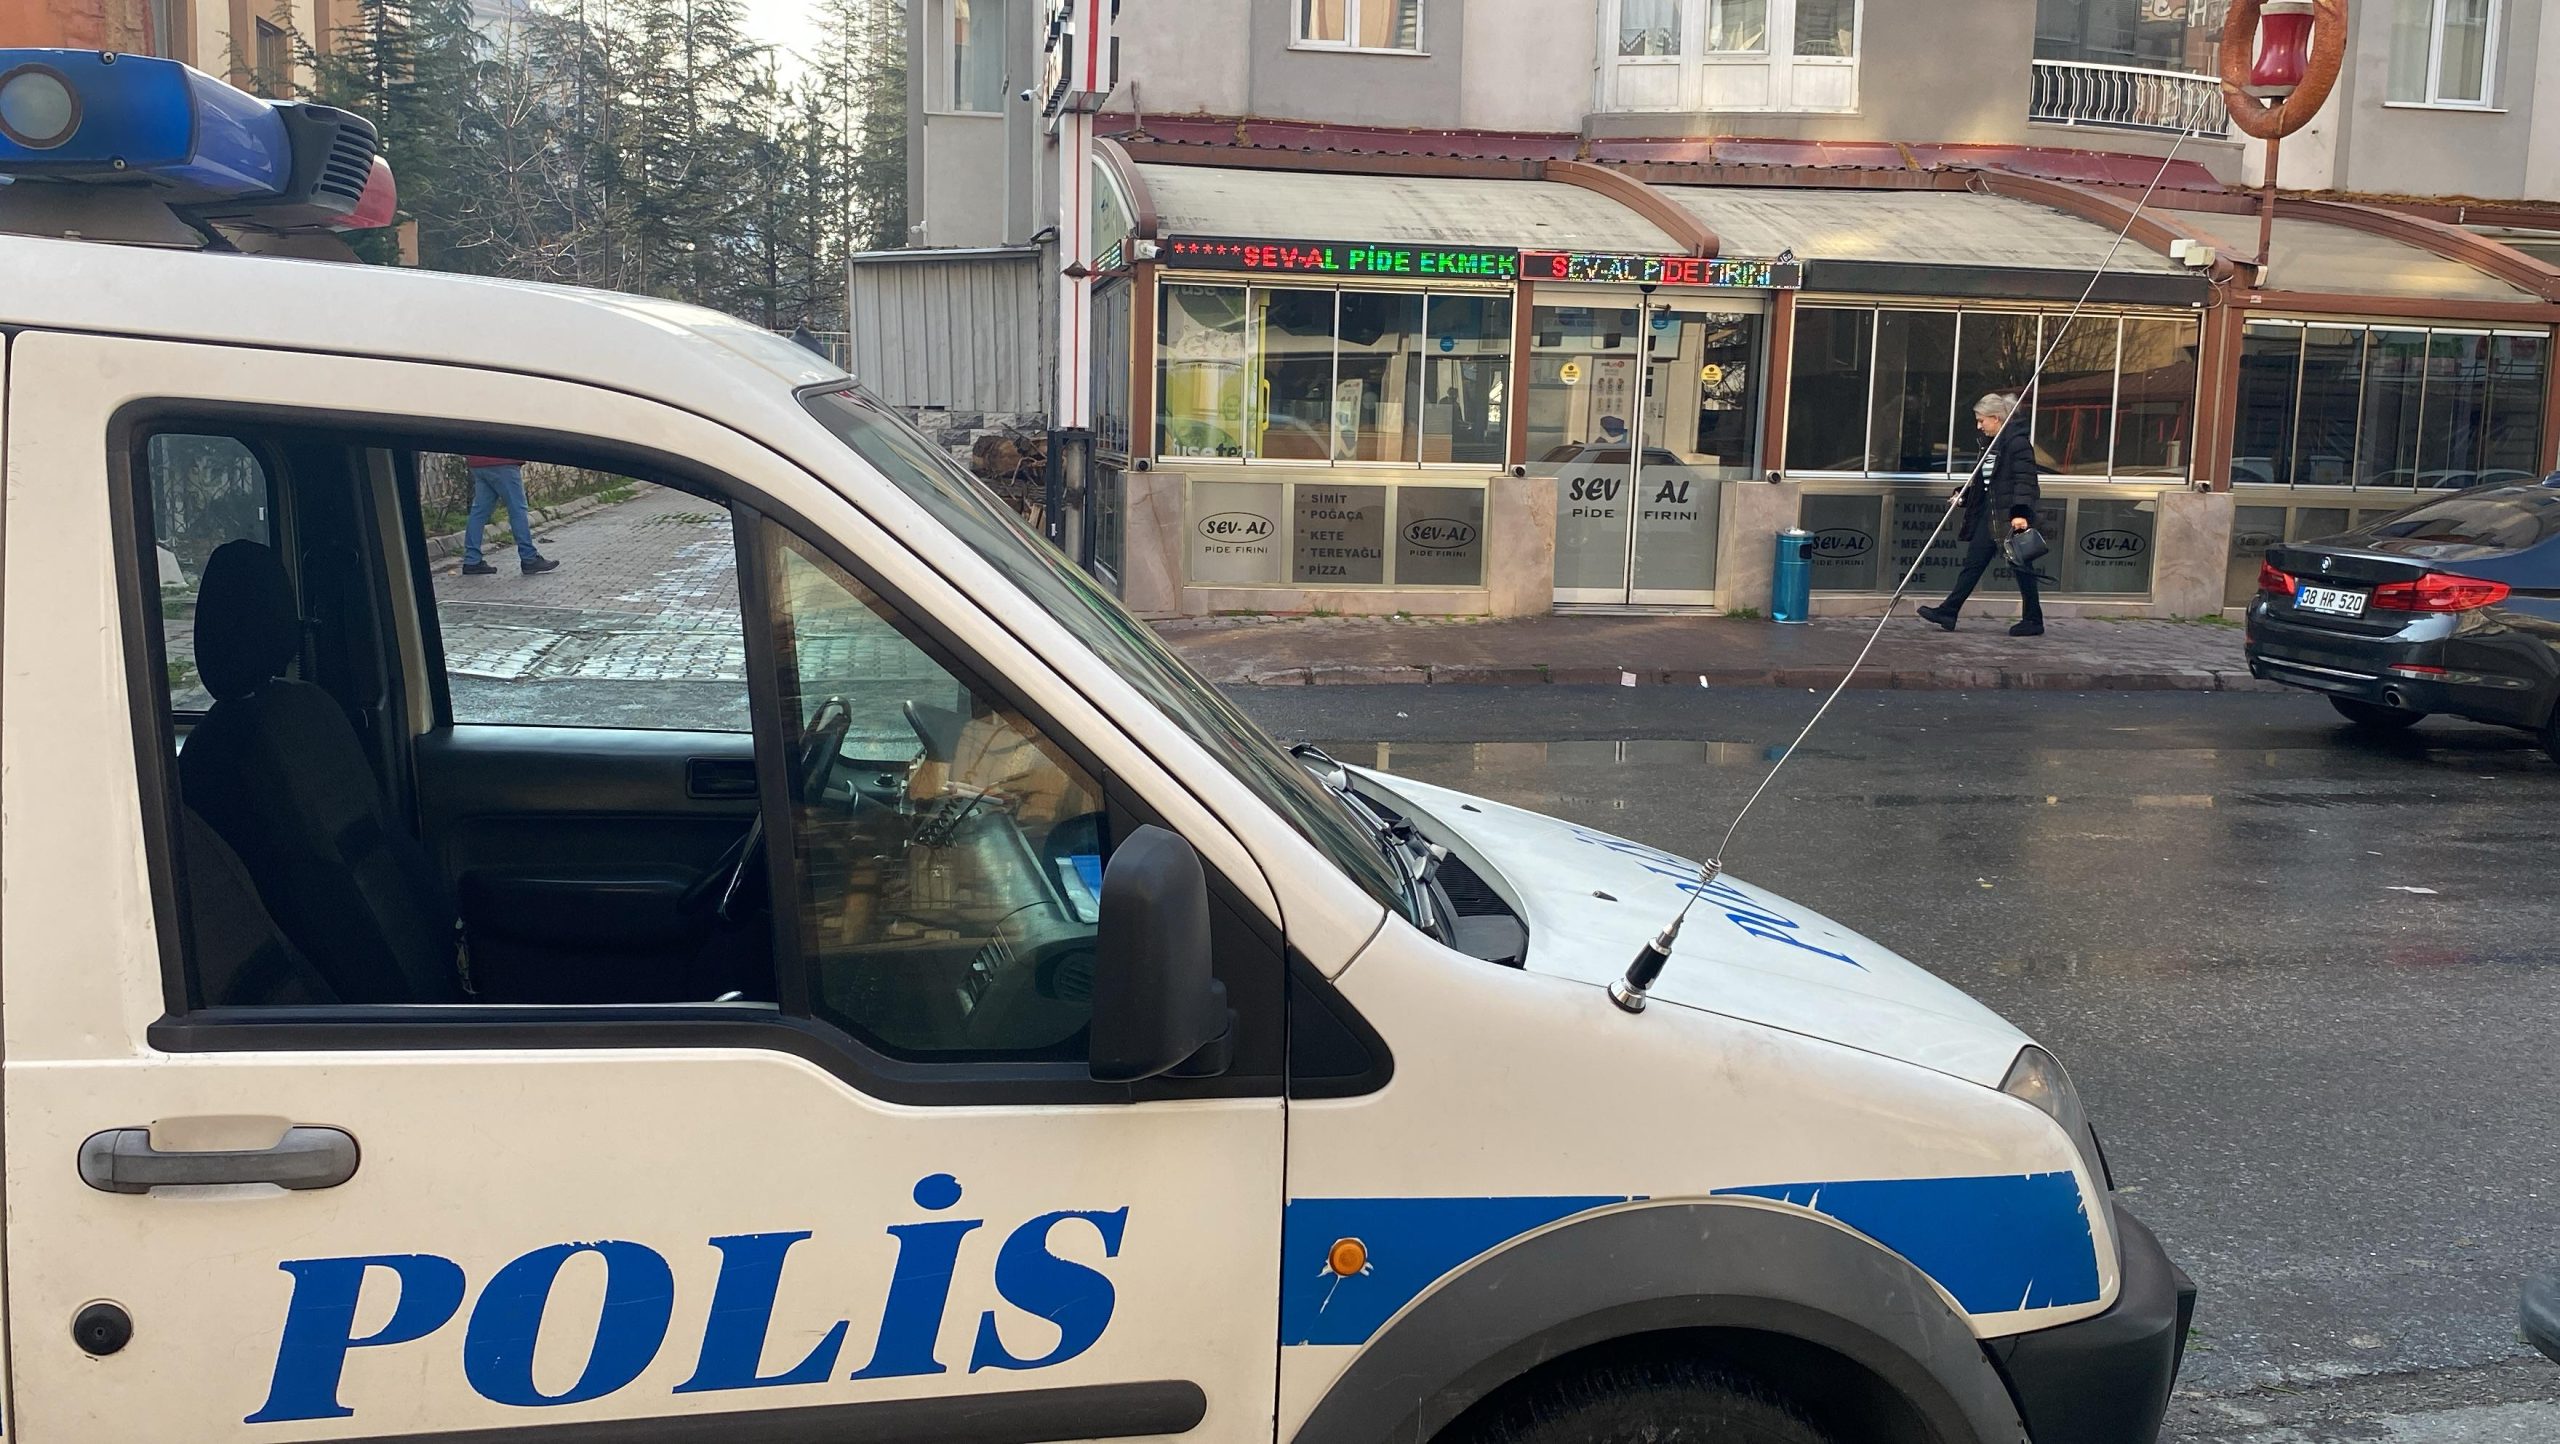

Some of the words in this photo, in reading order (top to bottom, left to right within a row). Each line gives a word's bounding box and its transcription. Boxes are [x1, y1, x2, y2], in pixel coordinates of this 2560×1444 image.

[1244, 244, 1339, 269] SEV-AL
[1349, 244, 1411, 271] PİDE
[1420, 252, 1515, 275] EKMEK
[1569, 477, 1621, 501] SEV
[1655, 480, 1690, 504] AL
[1311, 493, 1347, 504] SİMİT
[1310, 508, 1364, 523] POĞAÇA
[1572, 506, 1615, 518] PİDE
[1644, 511, 1697, 521] FIRINI
[1310, 530, 1344, 541] KETE
[1411, 526, 1468, 540] SEV-AL
[1236, 546, 1268, 554] FIRINI
[2086, 537, 2138, 551] SEV-AL
[1311, 546, 1382, 559] TEREYAĞLI
[1309, 564, 1347, 576] PİZZA
[2302, 589, 2318, 605] 38
[2319, 591, 2336, 607] HR
[2338, 594, 2363, 611] 520
[244, 1173, 1129, 1425] POLİS
